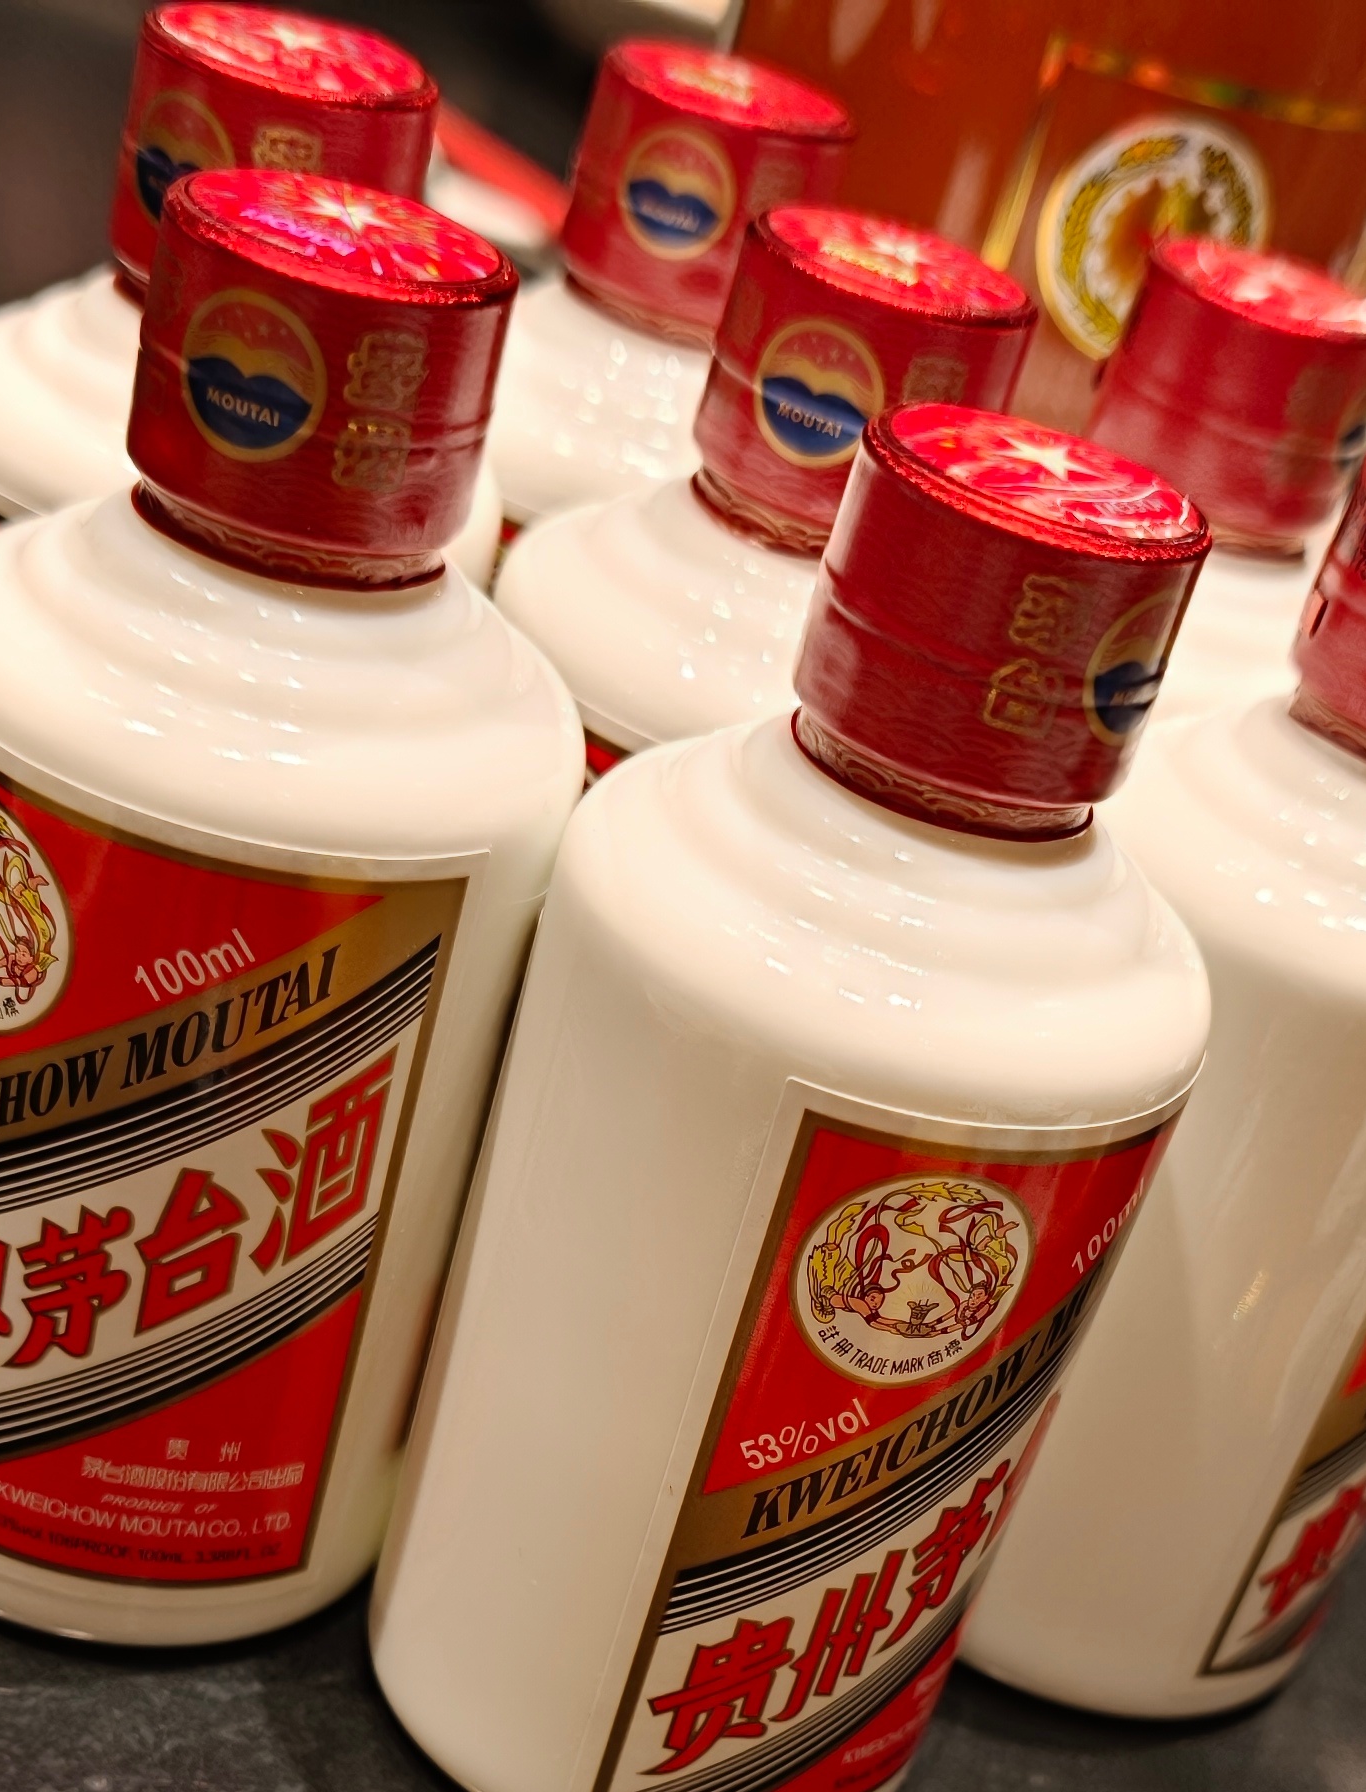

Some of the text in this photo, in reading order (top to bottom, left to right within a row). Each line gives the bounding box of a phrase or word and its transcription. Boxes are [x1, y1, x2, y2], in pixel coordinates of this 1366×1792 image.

[206, 387, 280, 427] MOUTAI
[776, 401, 842, 438] MOUTAI
[135, 928, 255, 1001] 100ml
[120, 944, 341, 1090] MOUTAI
[1071, 1177, 1145, 1275] 100ml
[849, 1349, 890, 1375] TRADE
[890, 1356, 924, 1375] MARK
[927, 1339, 963, 1367] 商標
[740, 1398, 870, 1469] 53%vol
[741, 1331, 1041, 1540] KWEICHOW
[120, 1514, 203, 1538] MOUTAI
